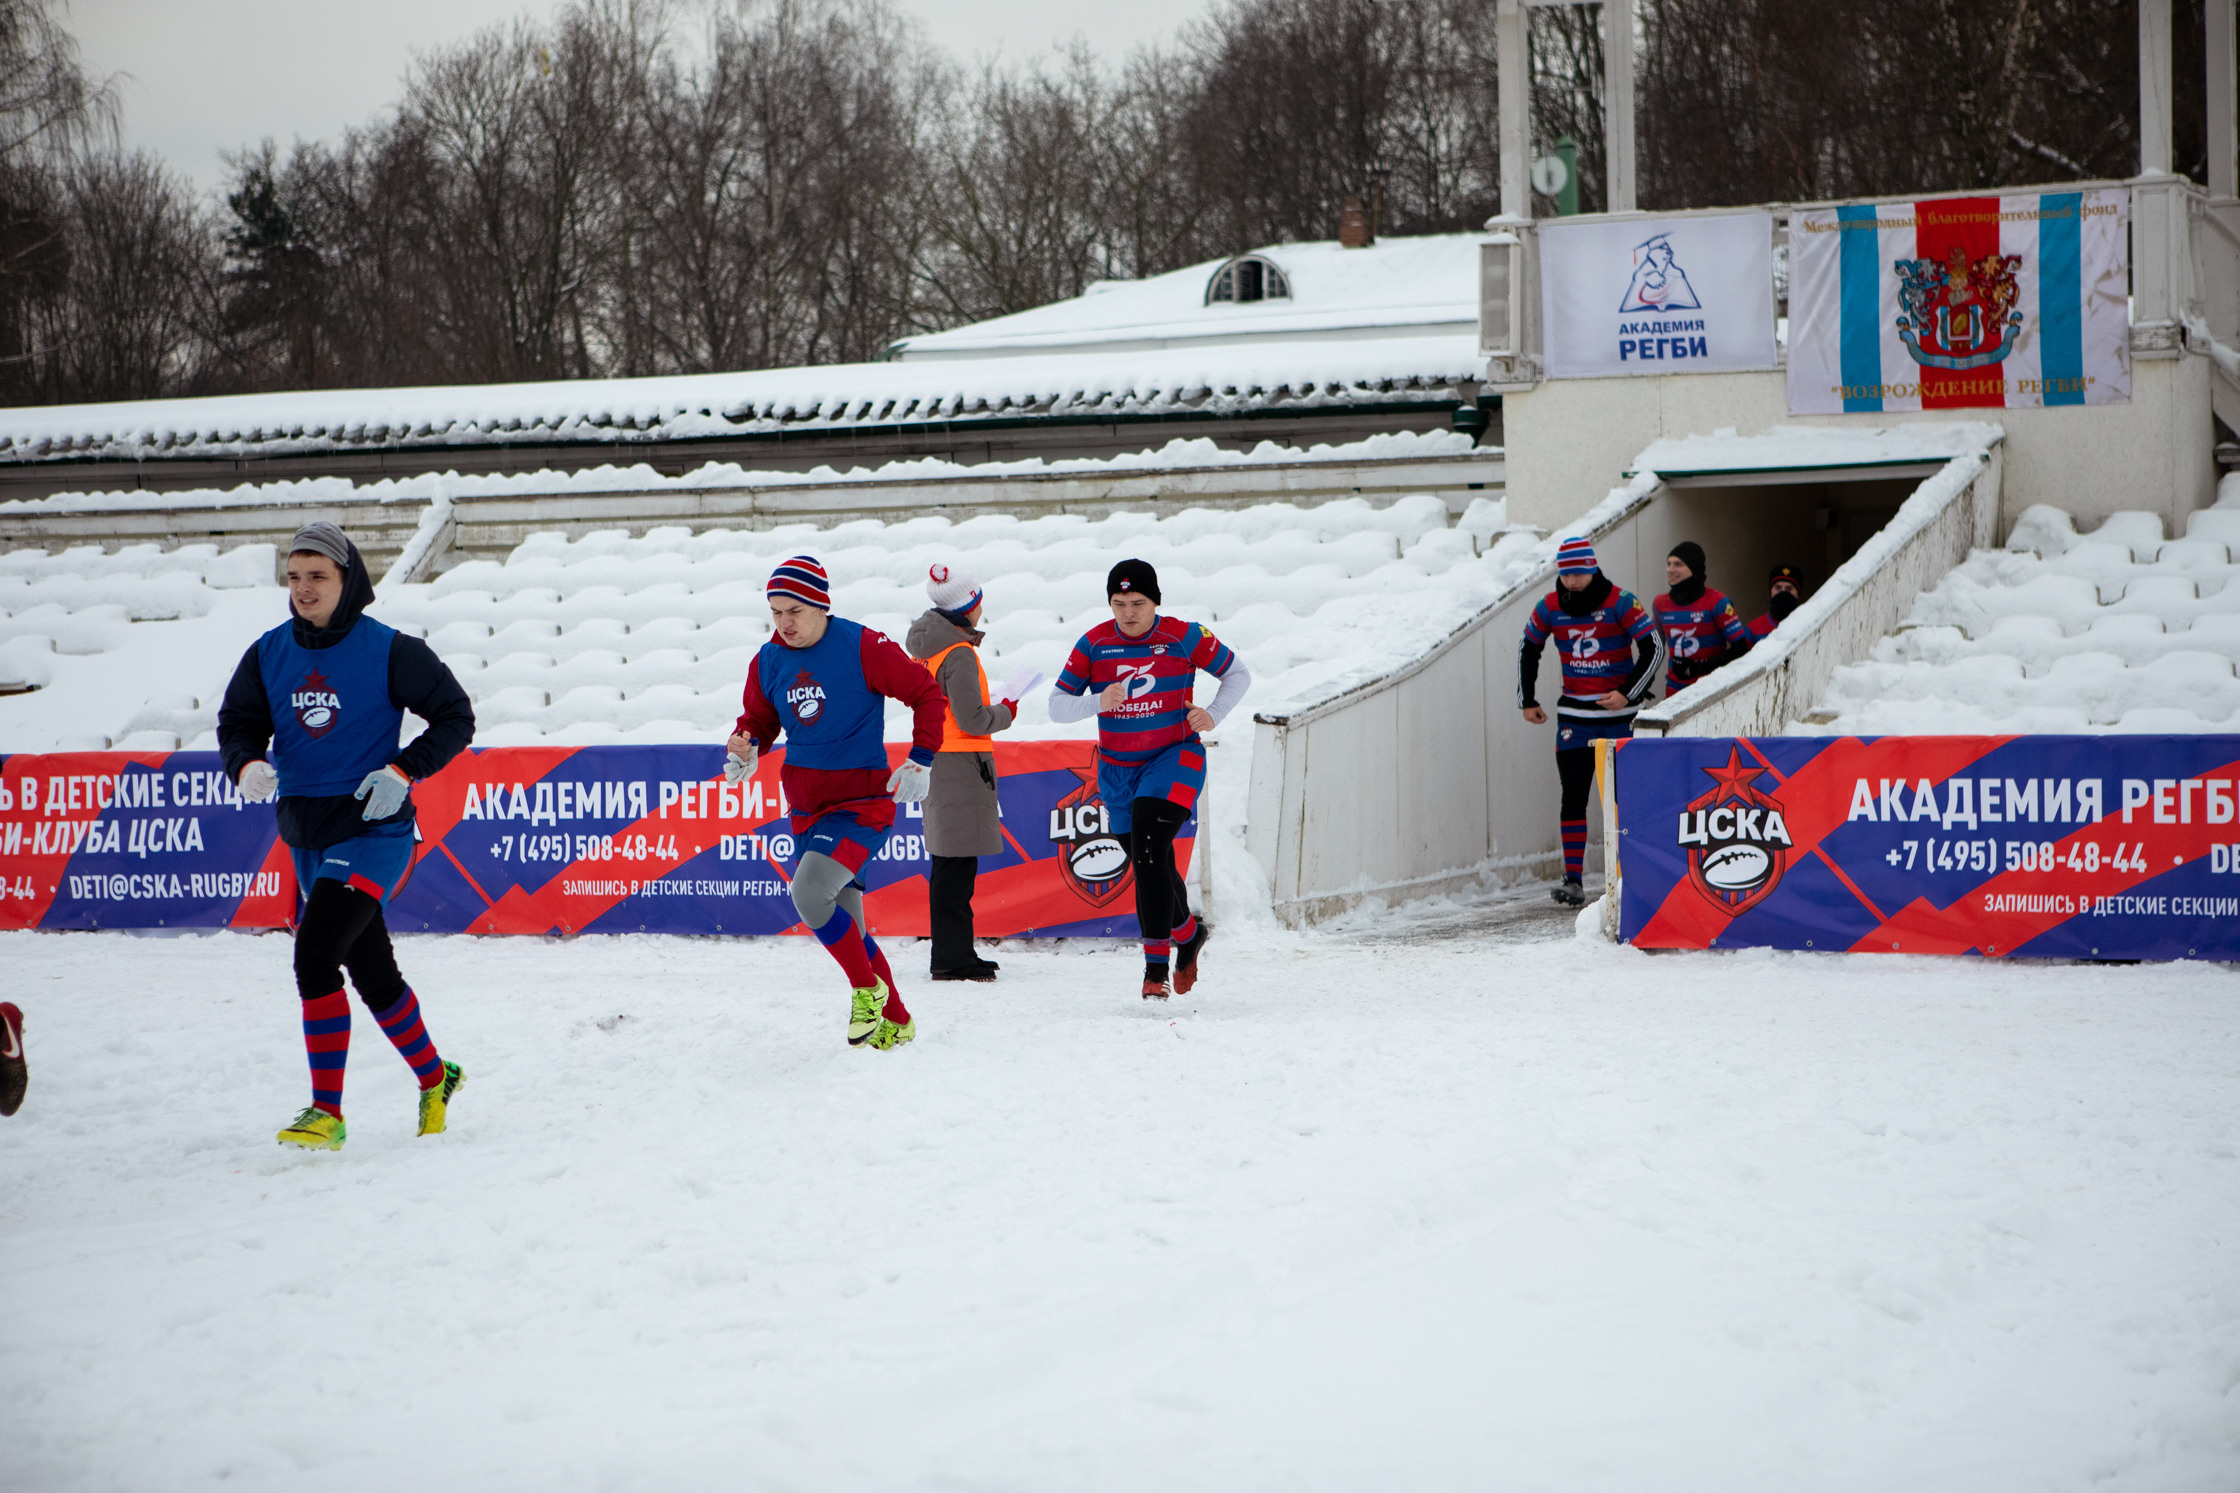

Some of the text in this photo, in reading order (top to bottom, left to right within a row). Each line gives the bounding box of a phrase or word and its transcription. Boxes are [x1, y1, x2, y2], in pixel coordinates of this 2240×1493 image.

[2079, 203, 2118, 221] фонд
[1619, 320, 1705, 335] АКАДЕМИЯ
[1619, 337, 1708, 361] РЕГБИ
[1568, 627, 1600, 659] 75
[1670, 626, 1700, 657] 75
[787, 686, 827, 704] ЦСКА
[1117, 661, 1156, 700] 75
[291, 692, 341, 709] ЦСКА
[21, 776, 38, 811] В
[44, 773, 166, 816] ДЕТСКИЕ
[172, 771, 280, 811] СЕКЦ
[462, 782, 648, 826] АКАДЕМИЯ
[1847, 778, 2240, 830] АКАДЕМИЯ РЕГБ
[0, 817, 204, 859] И-КЛУБА ЦСКА
[1678, 807, 1793, 845] ЦСКА
[490, 835, 513, 861] +7
[519, 833, 570, 864] (495)
[576, 834, 679, 862] 508-48-44
[1885, 840, 1918, 871] +7
[1926, 837, 1997, 875] (495)
[2005, 841, 2148, 873] 508-48-44
[69, 872, 280, 901] DETI@CSKA-RUGBY.RU
[563, 880, 628, 895] ЗАПИШИСЬ
[631, 880, 639, 895] В
[641, 880, 693, 897] ДЕТСКИЕ
[696, 880, 739, 898] СЕКЦИИ
[1984, 894, 2239, 919] ЗАПИШИСЬ В ДЕТСКИЕ СЕКЦИИ
